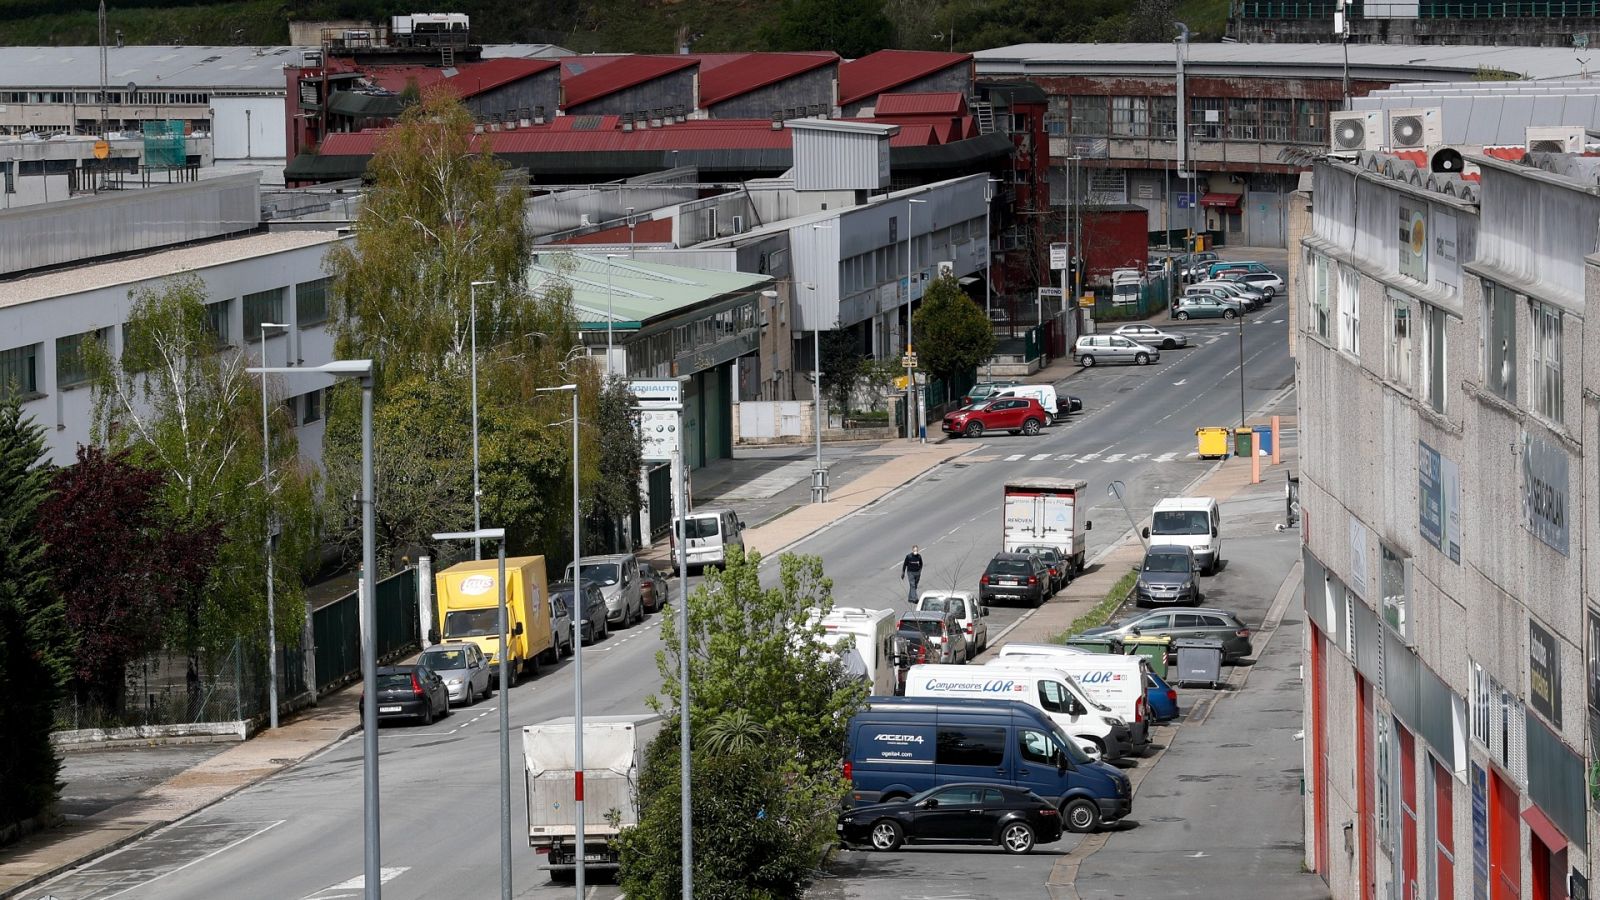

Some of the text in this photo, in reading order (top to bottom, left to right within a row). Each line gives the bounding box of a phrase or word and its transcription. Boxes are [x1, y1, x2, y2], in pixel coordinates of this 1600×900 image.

[1082, 671, 1113, 683] LOR
[925, 679, 982, 691] Compresores
[983, 680, 1014, 692] LOR
